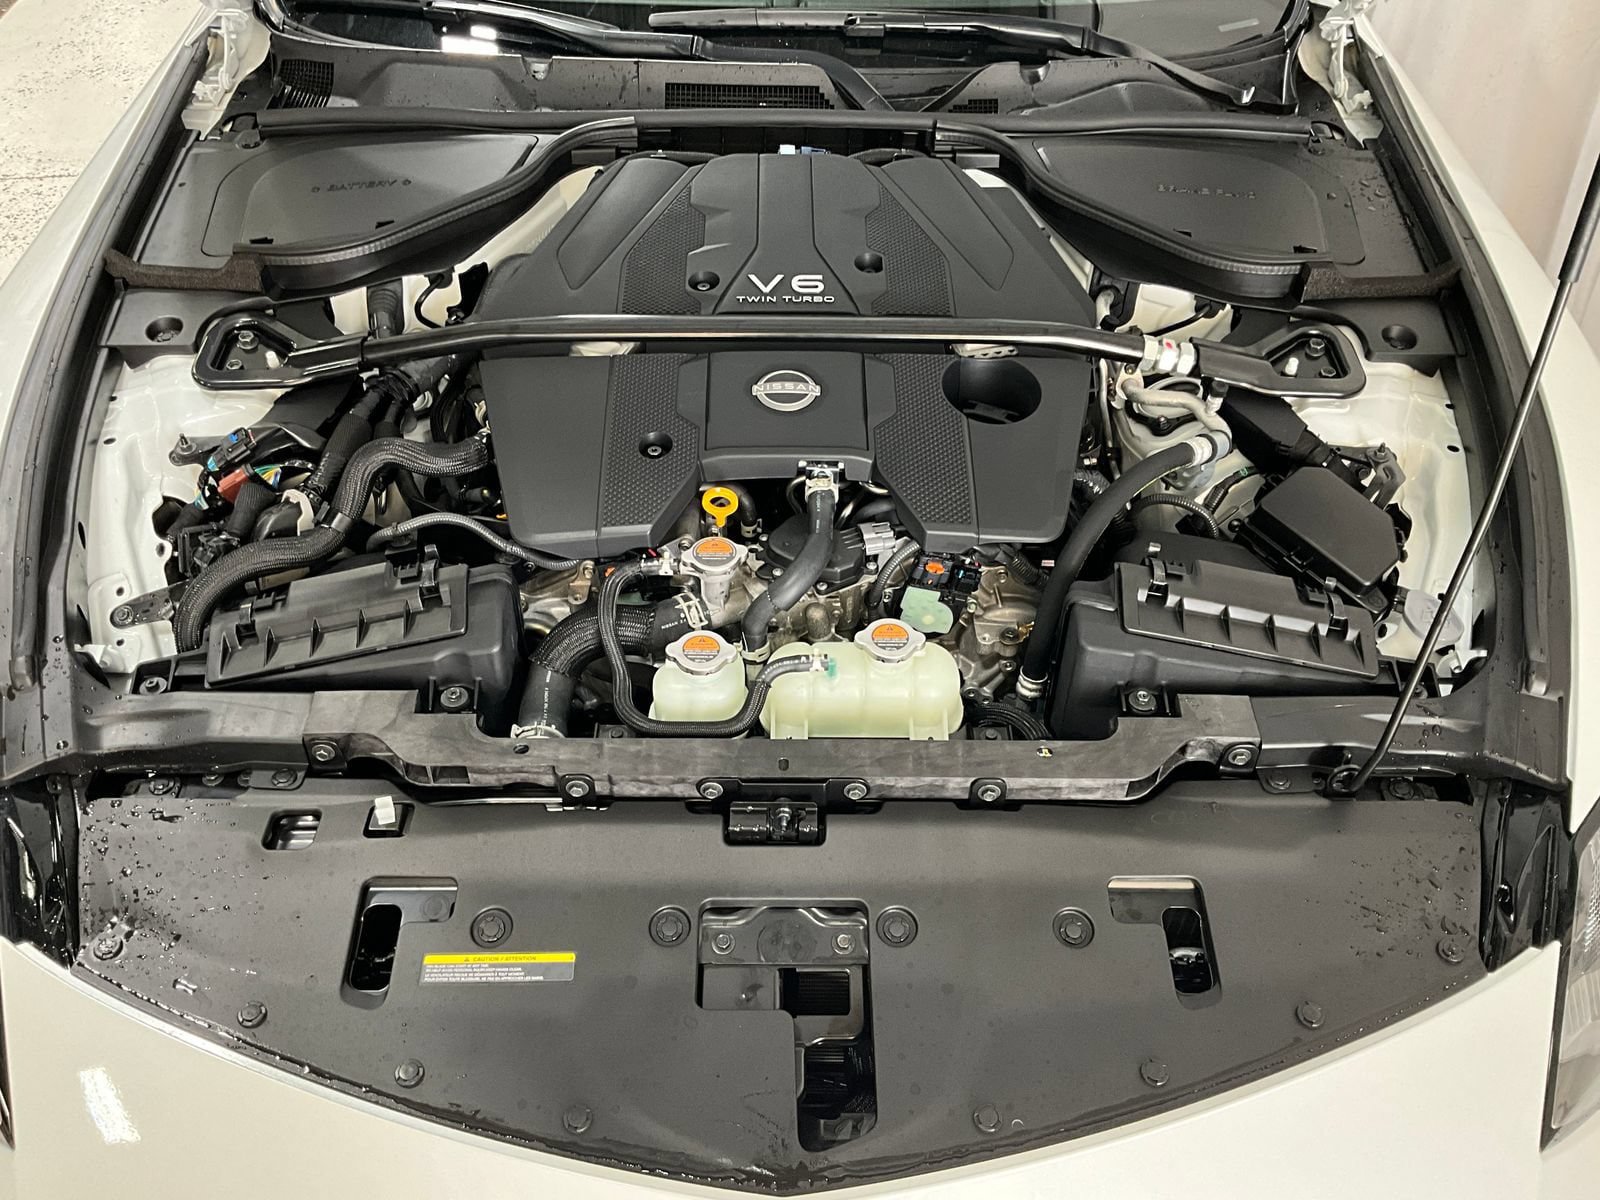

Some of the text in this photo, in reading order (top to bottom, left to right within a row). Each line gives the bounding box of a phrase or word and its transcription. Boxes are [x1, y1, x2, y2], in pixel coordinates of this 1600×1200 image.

[327, 179, 398, 192] BATTERY
[747, 273, 825, 294] V6
[736, 295, 835, 303] TWIN TURBO
[754, 383, 820, 393] NISSAN
